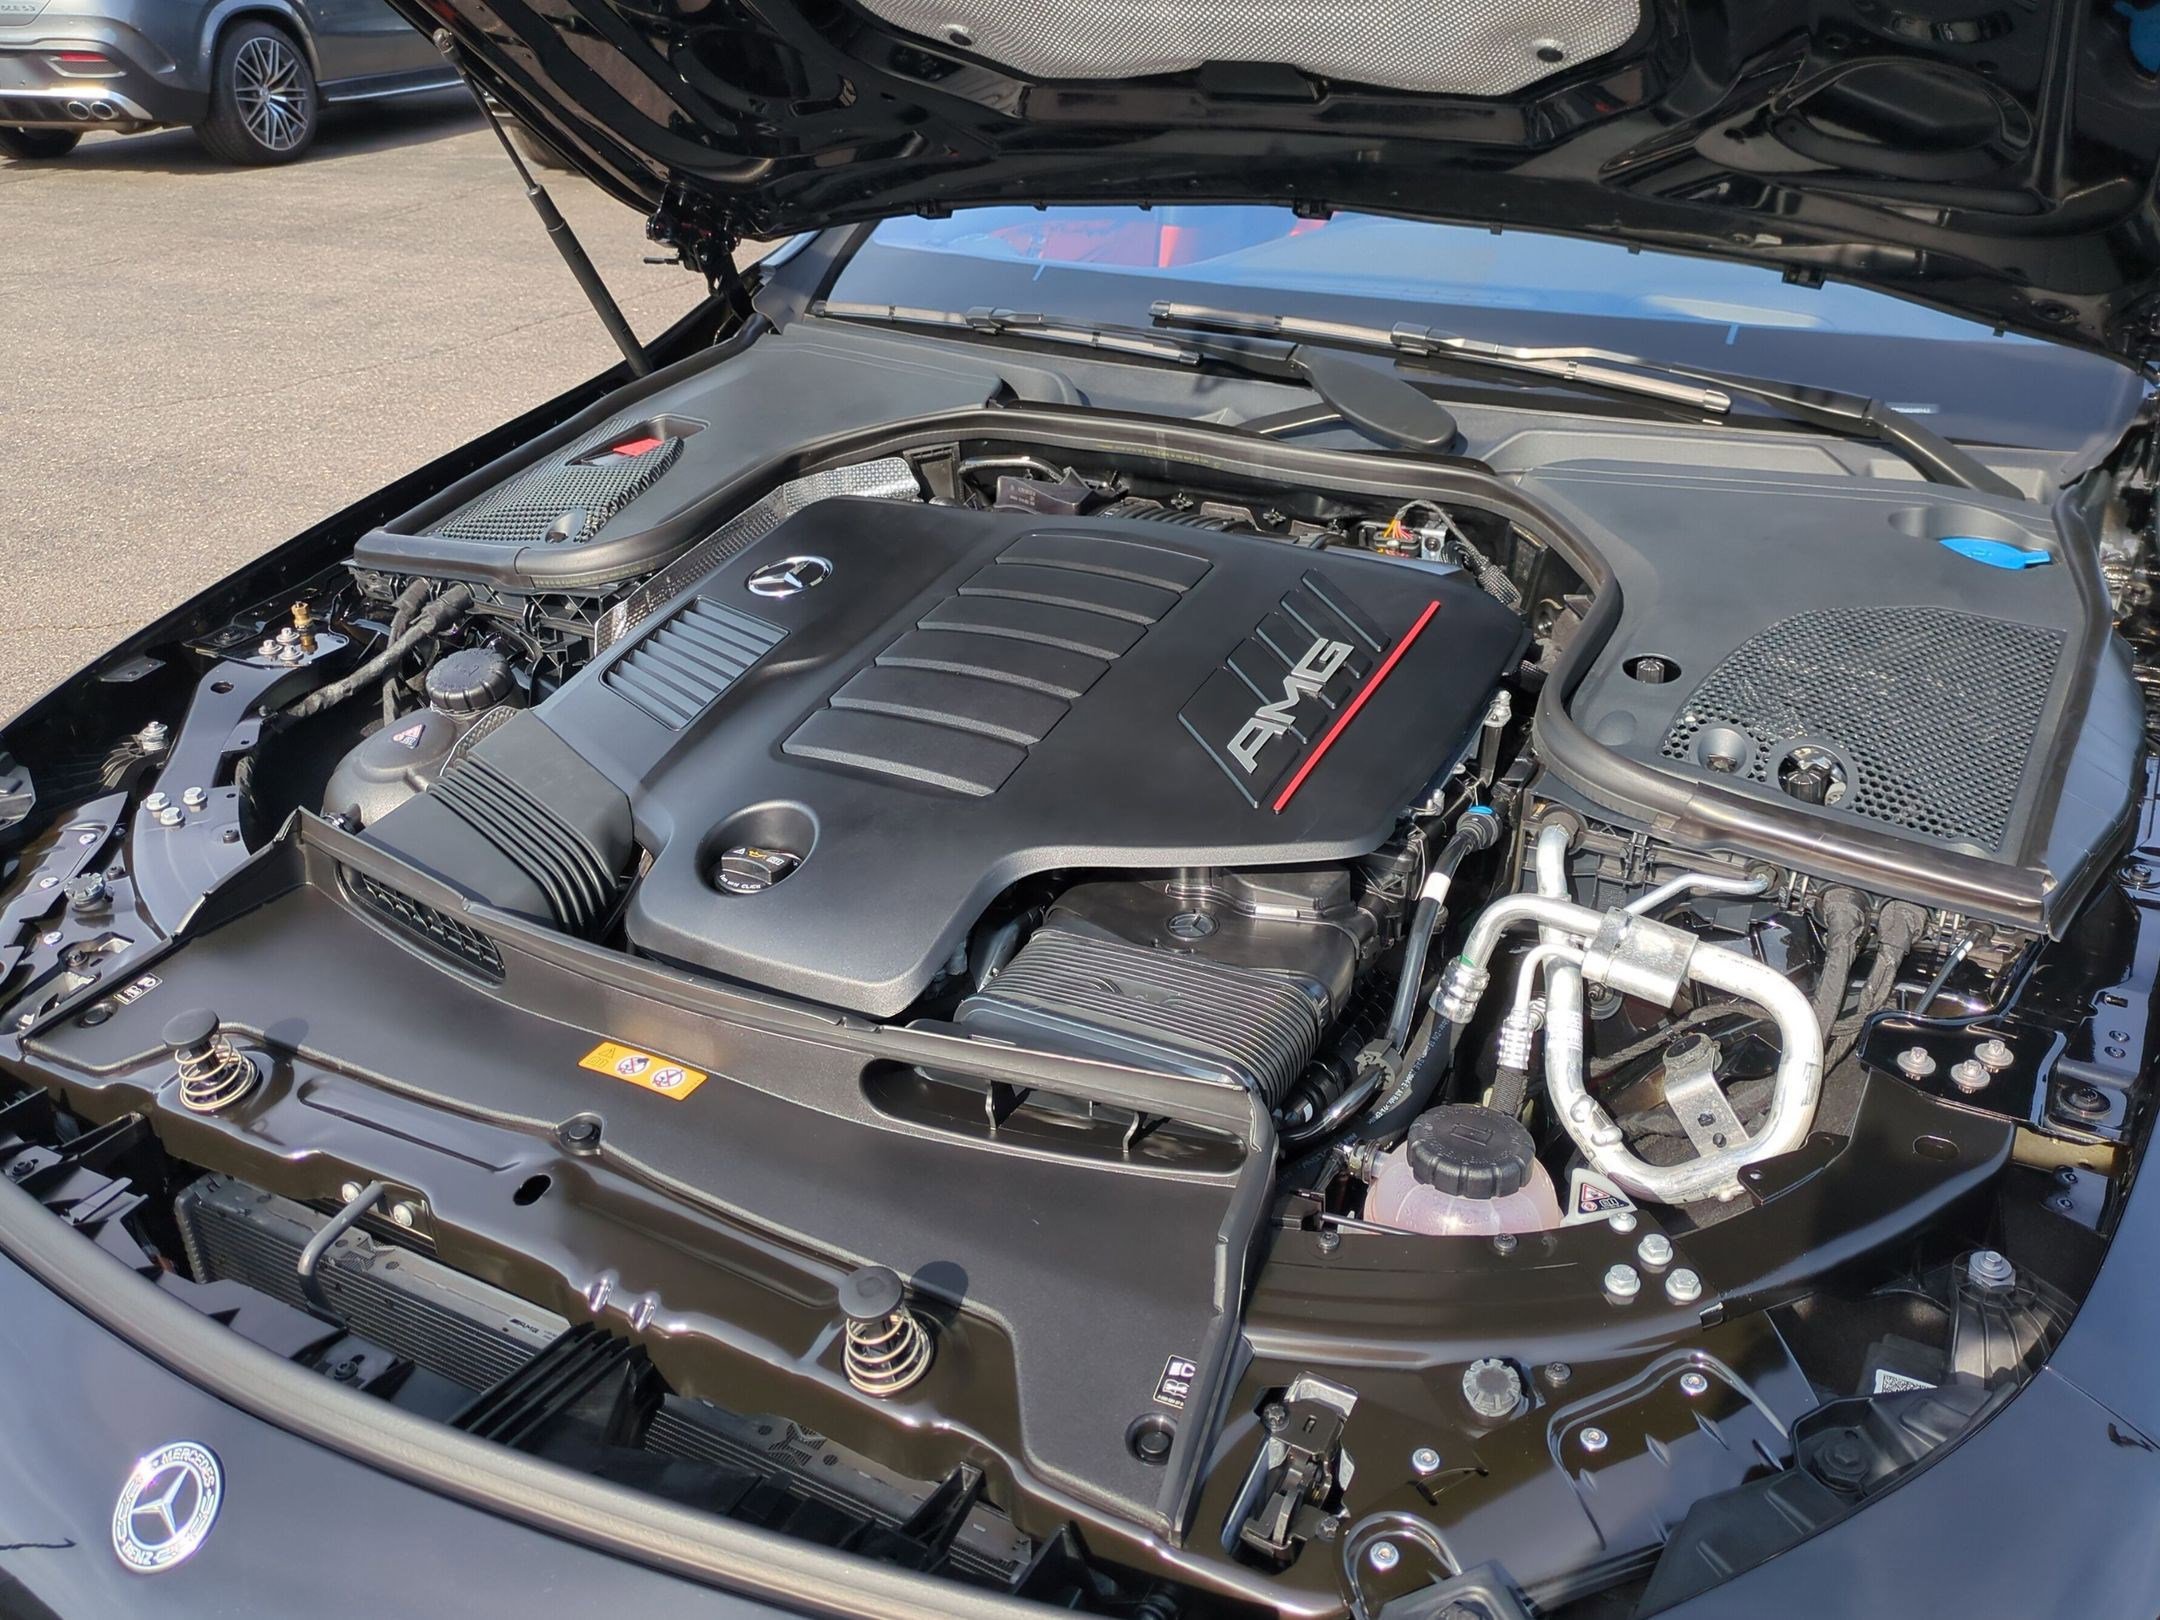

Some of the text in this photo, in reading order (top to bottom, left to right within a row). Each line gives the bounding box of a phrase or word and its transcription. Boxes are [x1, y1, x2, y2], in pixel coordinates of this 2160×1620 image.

[1227, 637, 1355, 774] AMG
[161, 1448, 215, 1488] MERCEDES
[122, 1541, 154, 1565] BENZ
